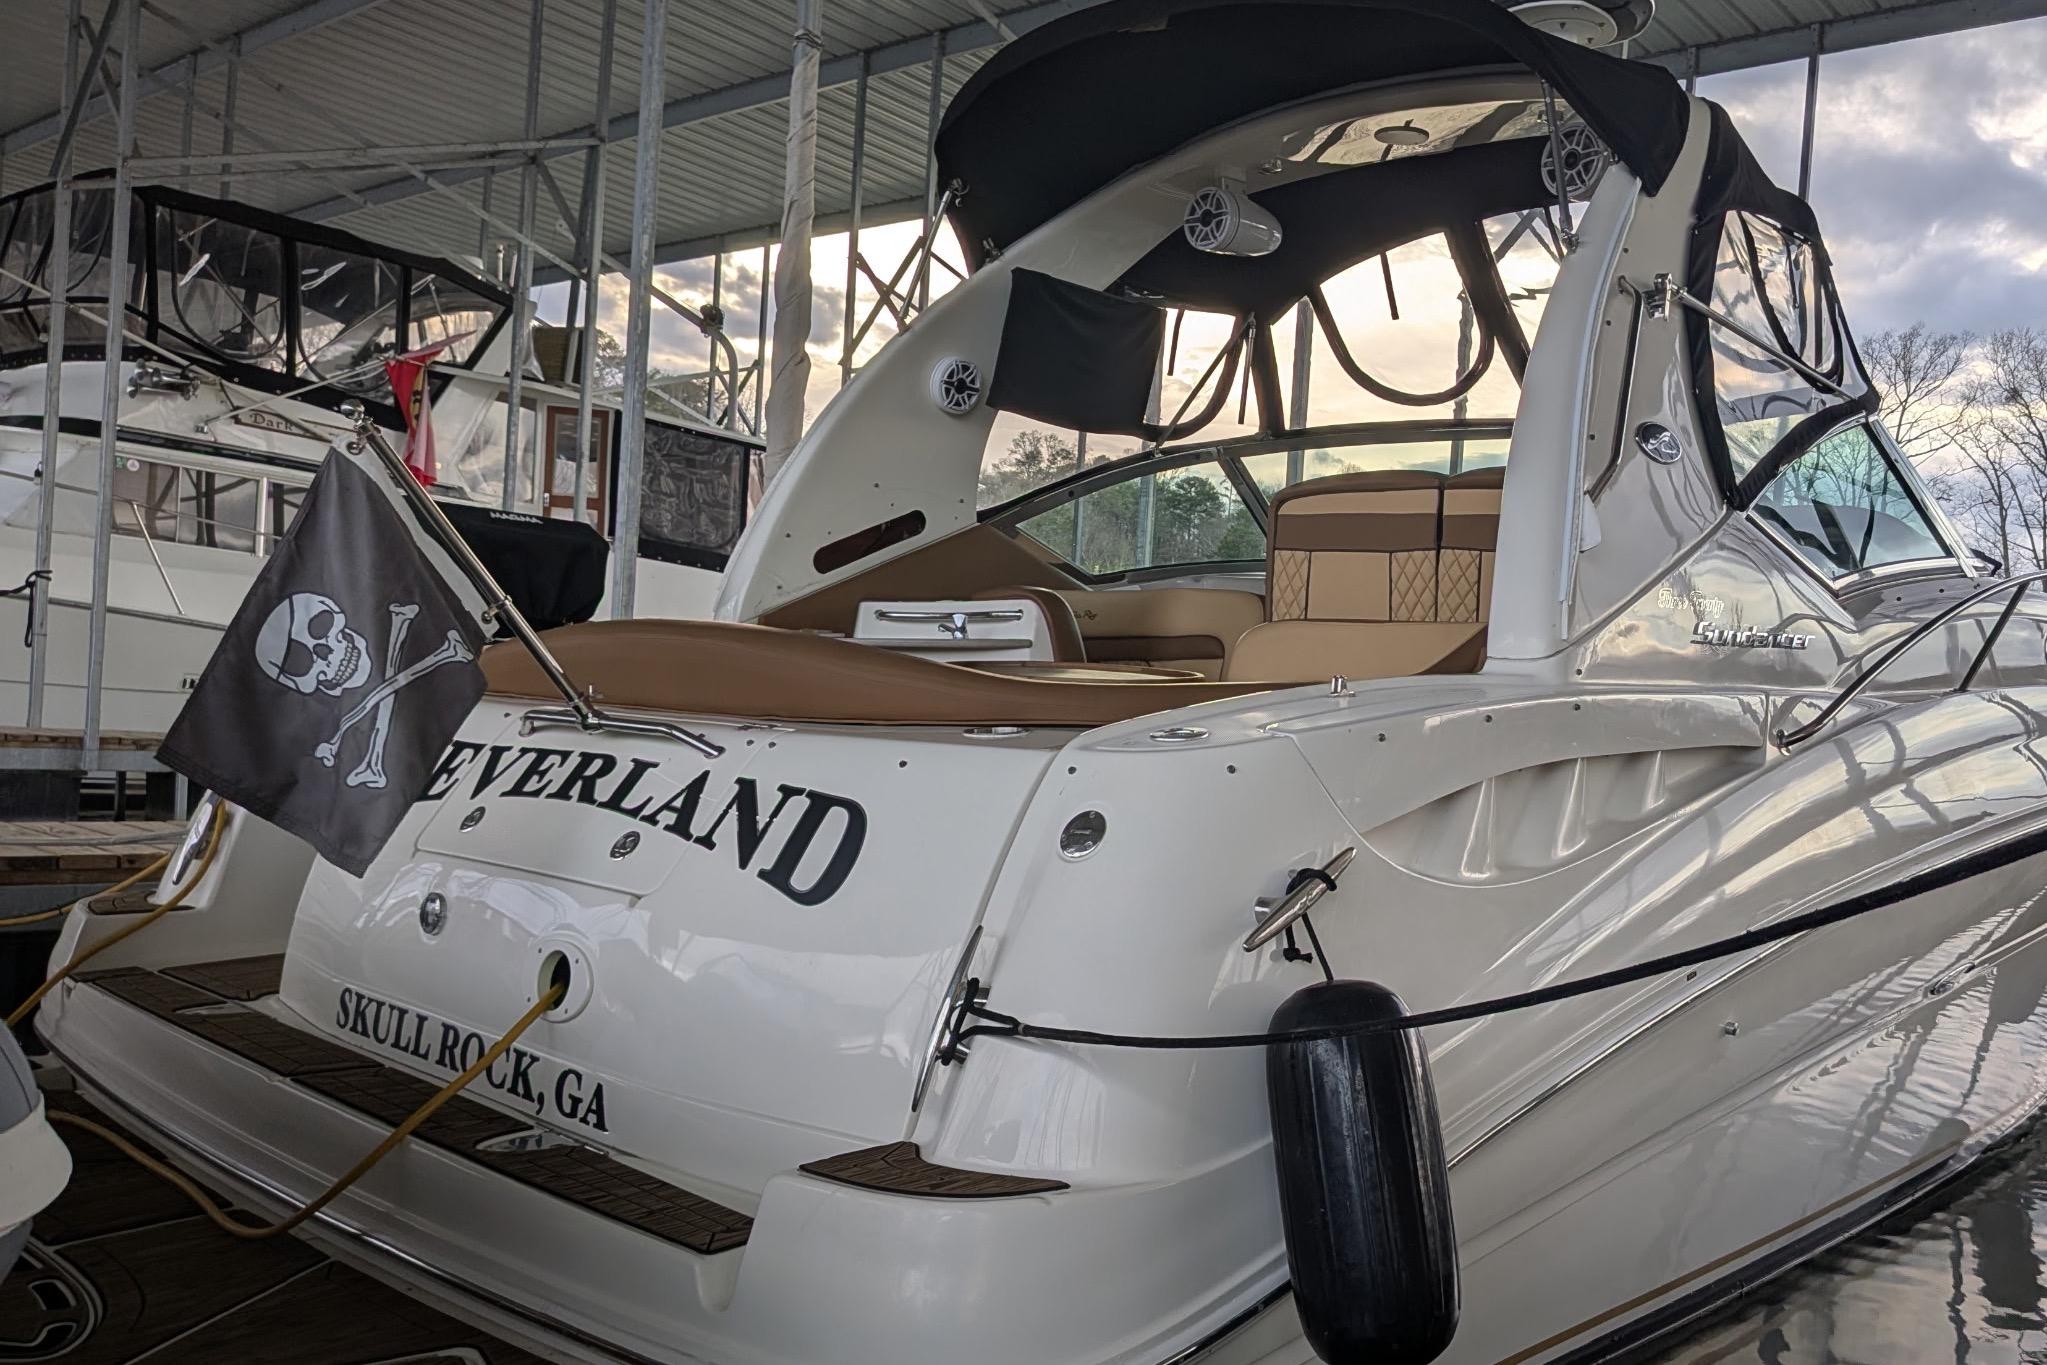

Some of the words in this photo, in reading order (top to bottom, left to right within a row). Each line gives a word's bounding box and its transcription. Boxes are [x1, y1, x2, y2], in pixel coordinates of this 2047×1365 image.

[249, 413, 293, 431] Dark
[1692, 621, 1816, 649] Sundancer
[411, 740, 868, 907] EVERLAND
[336, 987, 431, 1061] SKULL
[434, 1021, 546, 1116] ROCK,
[554, 1068, 610, 1133] GA
